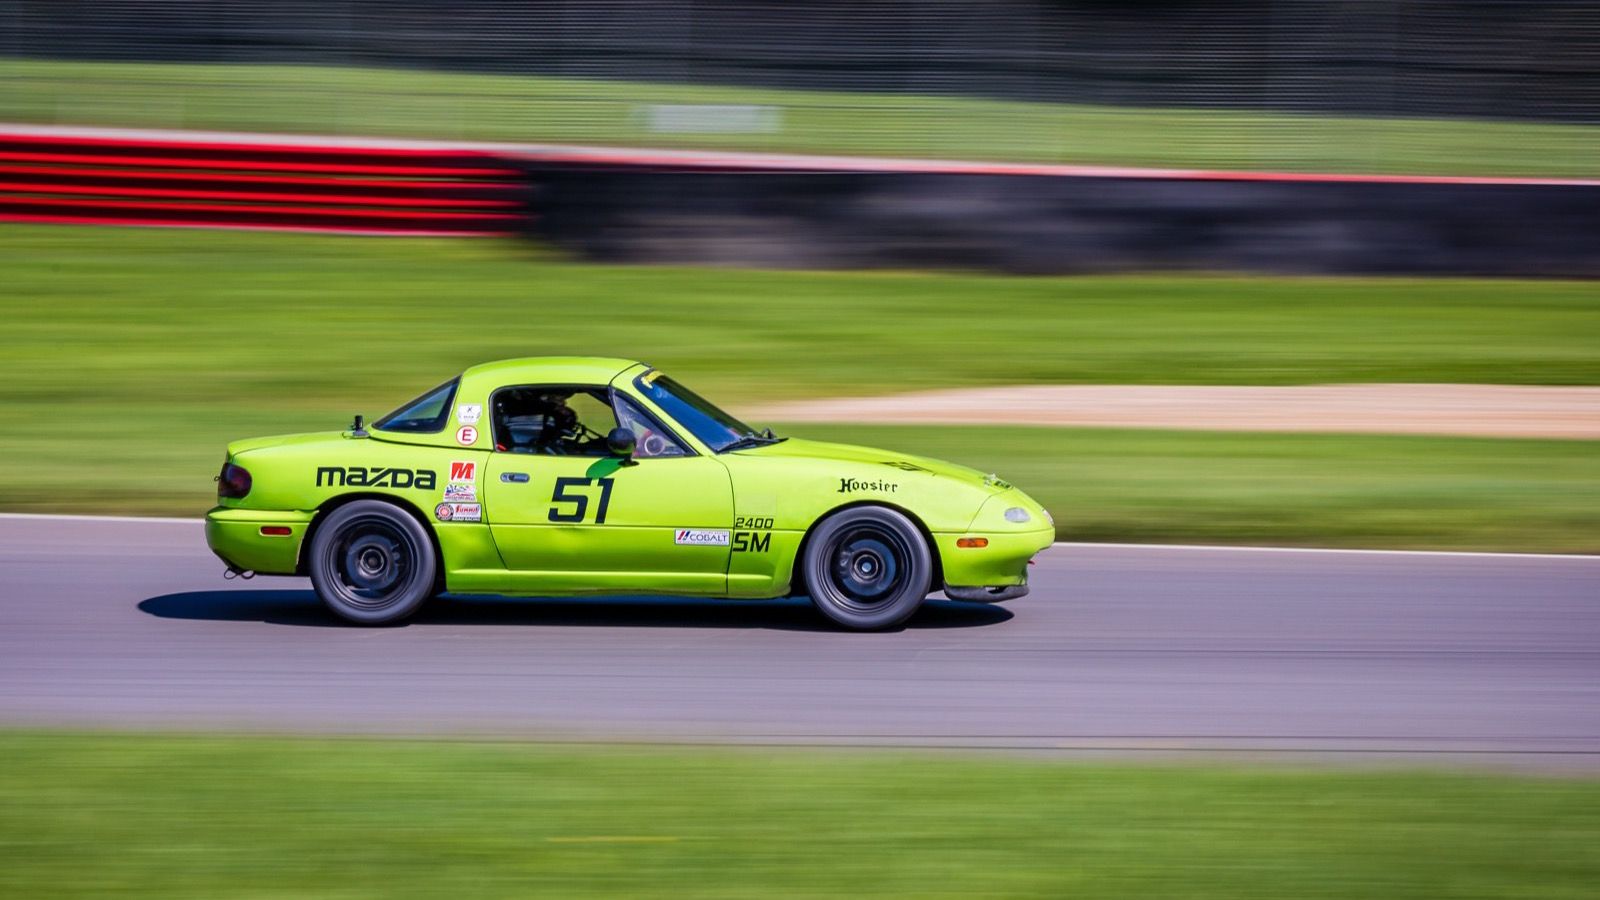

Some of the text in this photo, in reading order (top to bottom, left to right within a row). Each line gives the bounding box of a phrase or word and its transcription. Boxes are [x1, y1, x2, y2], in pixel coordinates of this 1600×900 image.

[462, 429, 472, 441] E
[837, 478, 898, 493] Hoosier
[548, 477, 615, 524] 51
[736, 517, 774, 529] 2400
[689, 533, 728, 542] COBALT
[733, 531, 771, 552] SM
